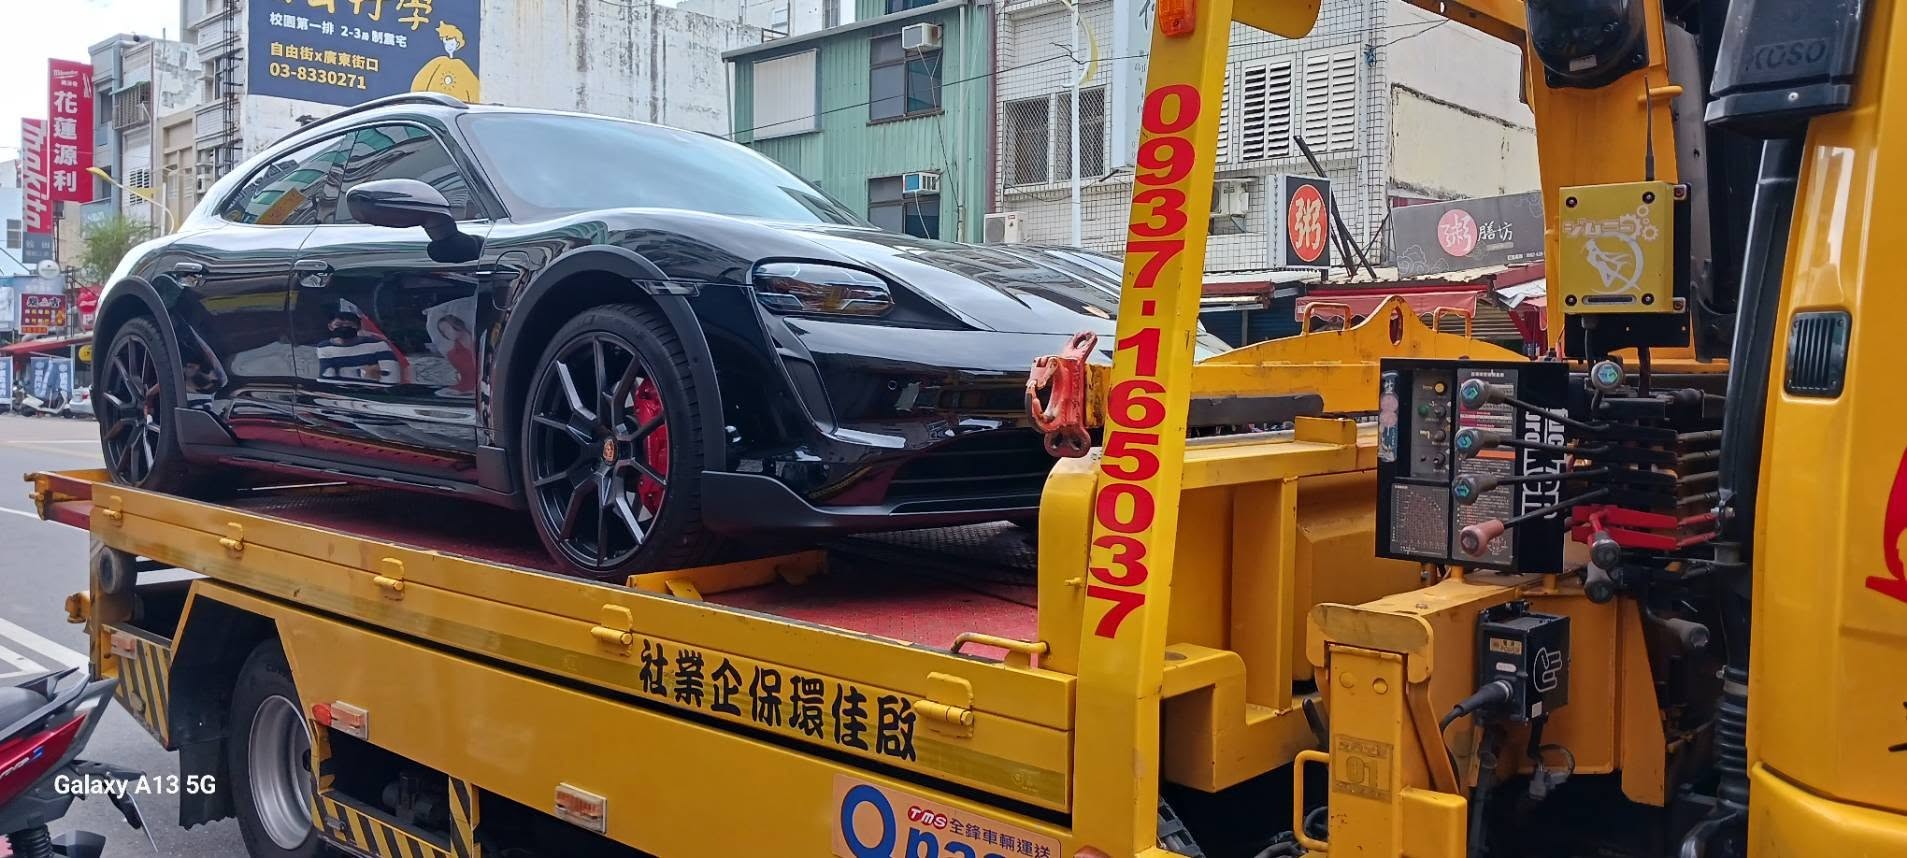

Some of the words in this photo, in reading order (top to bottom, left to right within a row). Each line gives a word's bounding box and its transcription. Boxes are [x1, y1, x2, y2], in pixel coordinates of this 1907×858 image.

[269, 62, 367, 91] 03-8330271
[53, 90, 78, 193] 花蓮源利
[23, 119, 48, 231] makita
[1294, 197, 1322, 250] 粥
[908, 806, 948, 830] TMS
[949, 817, 1051, 858] 全鋒車輛運送
